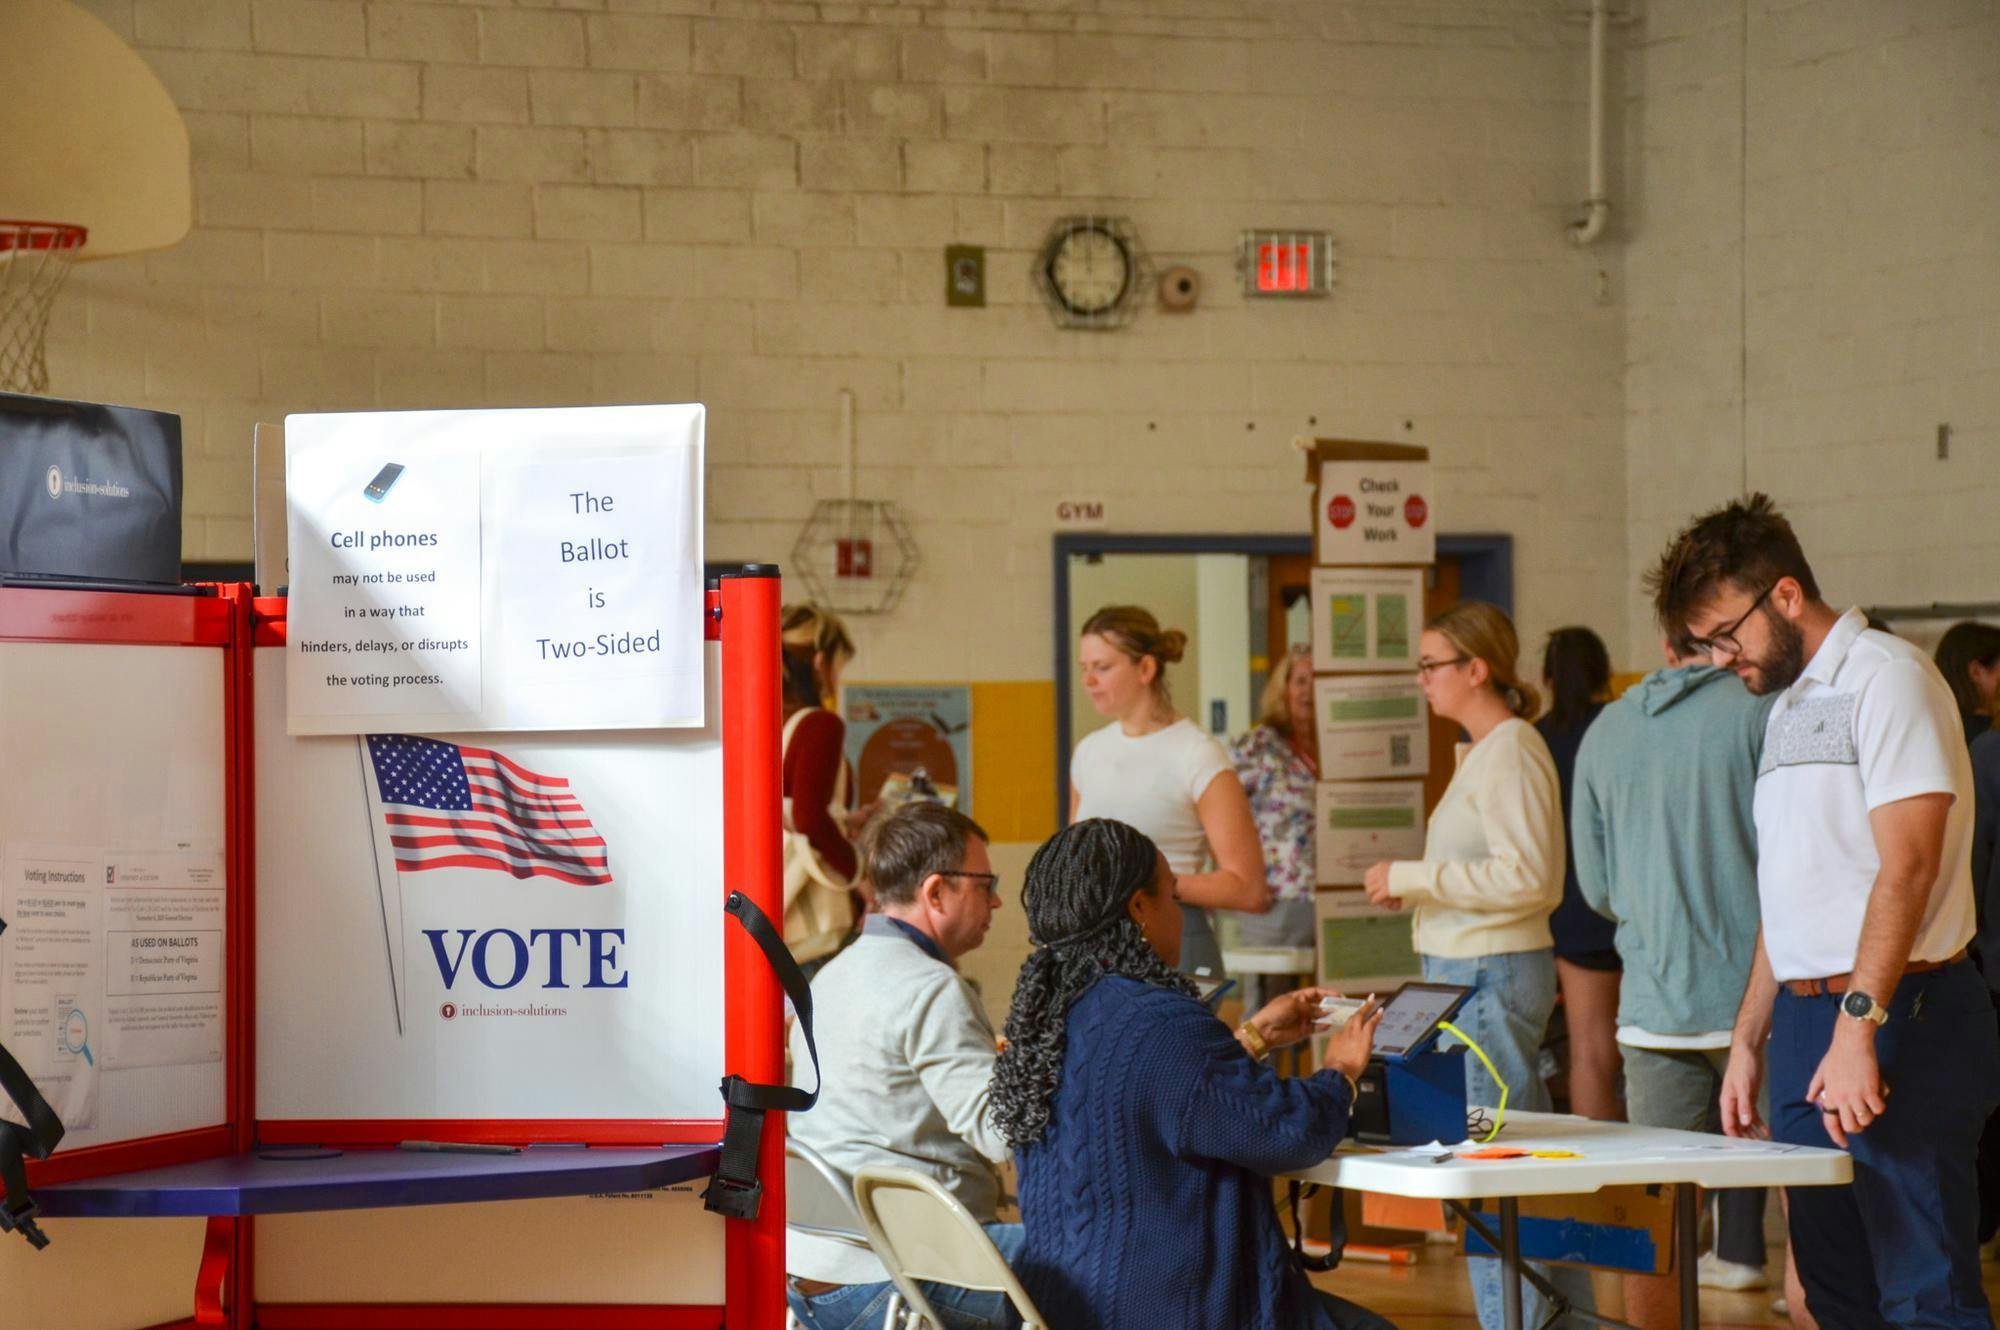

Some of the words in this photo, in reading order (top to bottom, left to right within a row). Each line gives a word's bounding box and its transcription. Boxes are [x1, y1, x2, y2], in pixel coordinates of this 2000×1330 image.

[1359, 478, 1399, 493] Check
[570, 490, 614, 515] The
[1366, 502, 1394, 517] Your
[1055, 501, 1104, 521] GYM
[330, 530, 364, 549] Cell
[370, 529, 438, 552] phones
[1363, 527, 1397, 541] Work
[560, 537, 630, 564] Ballot
[332, 574, 359, 586] may
[362, 573, 384, 584] not
[387, 571, 403, 583] be
[406, 570, 436, 583] used
[588, 587, 606, 609] is
[344, 606, 356, 618] in
[359, 608, 367, 618] a
[369, 608, 396, 619] way
[398, 605, 425, 617] that
[300, 640, 352, 654] hinders,
[355, 639, 398, 654] delays,
[401, 641, 415, 651] or
[417, 638, 469, 653] disrupts
[536, 628, 661, 661] Two-Sided
[326, 673, 348, 687] the
[350, 673, 390, 688] voting
[392, 674, 444, 688] process.
[24, 868, 47, 884] Voting
[47, 869, 86, 883] Instructions
[131, 938, 139, 948] AS
[140, 938, 156, 948] USED
[157, 938, 168, 948] ON
[169, 936, 199, 947] BALLOTS
[421, 928, 629, 990] VOTE
[462, 1003, 567, 1017] inclusion-solutions
